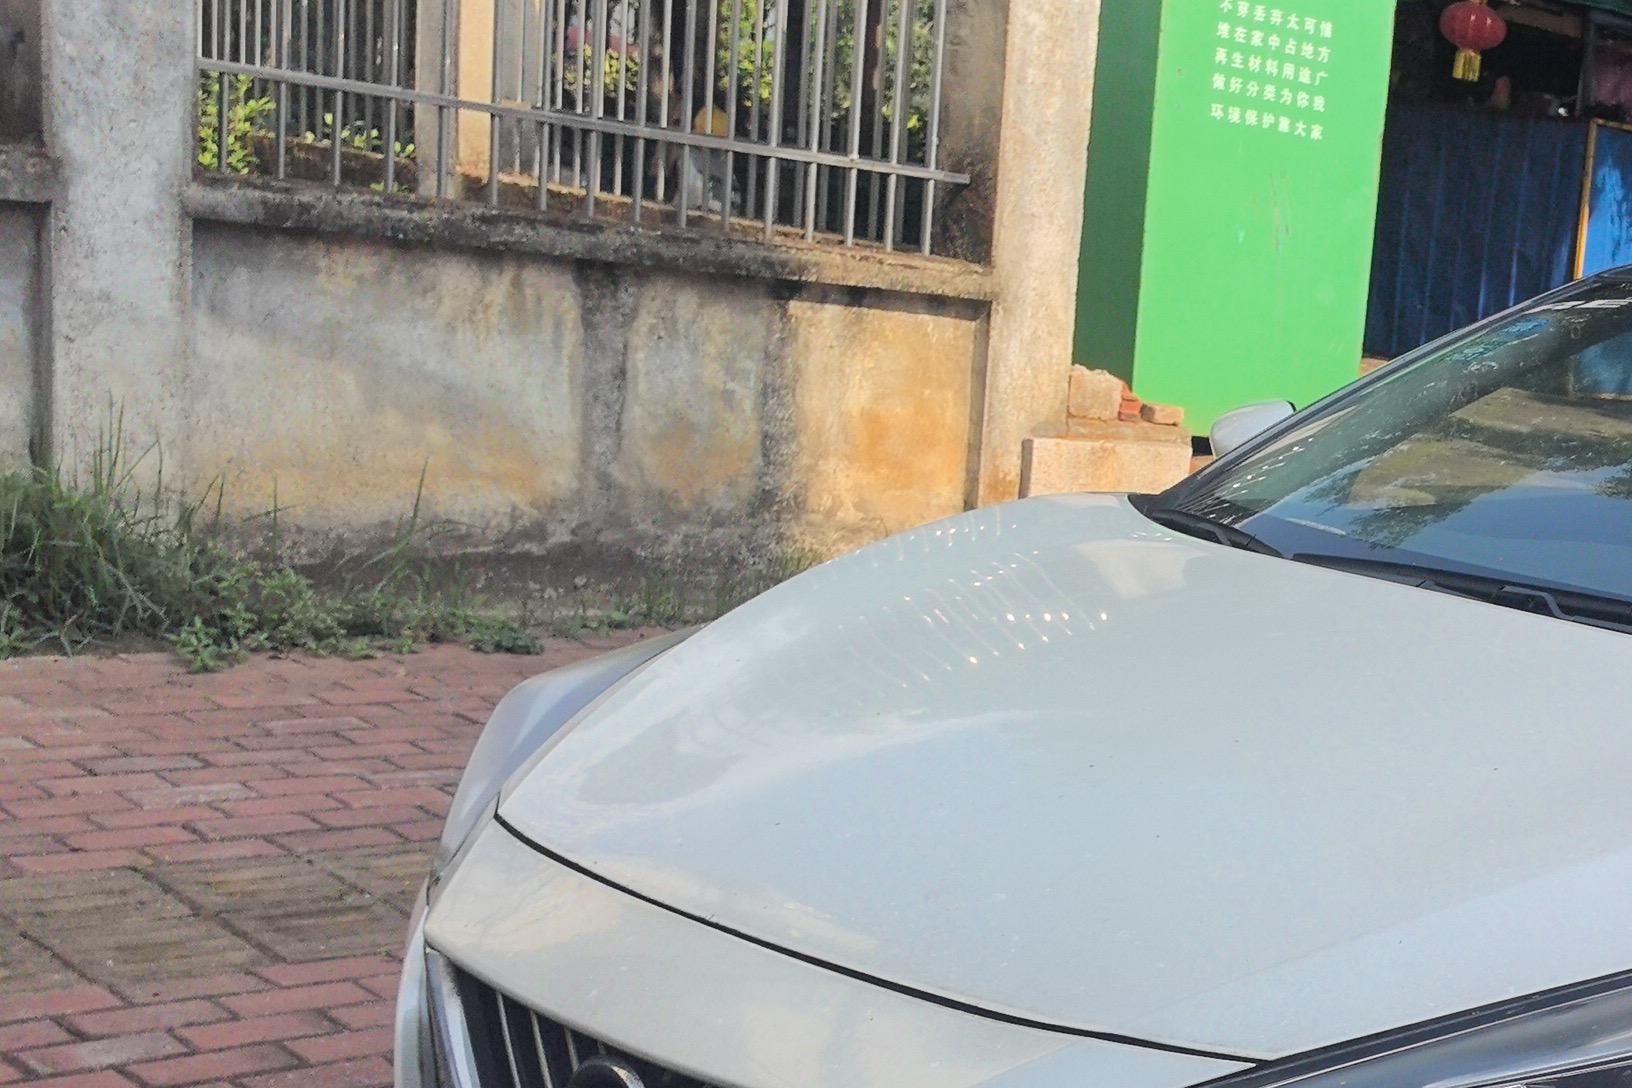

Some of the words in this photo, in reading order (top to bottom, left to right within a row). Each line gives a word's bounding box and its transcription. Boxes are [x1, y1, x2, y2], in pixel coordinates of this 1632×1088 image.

[1215, 47, 1328, 86] 再生材料用途广
[1210, 103, 1324, 140] 环境保护靠大家
